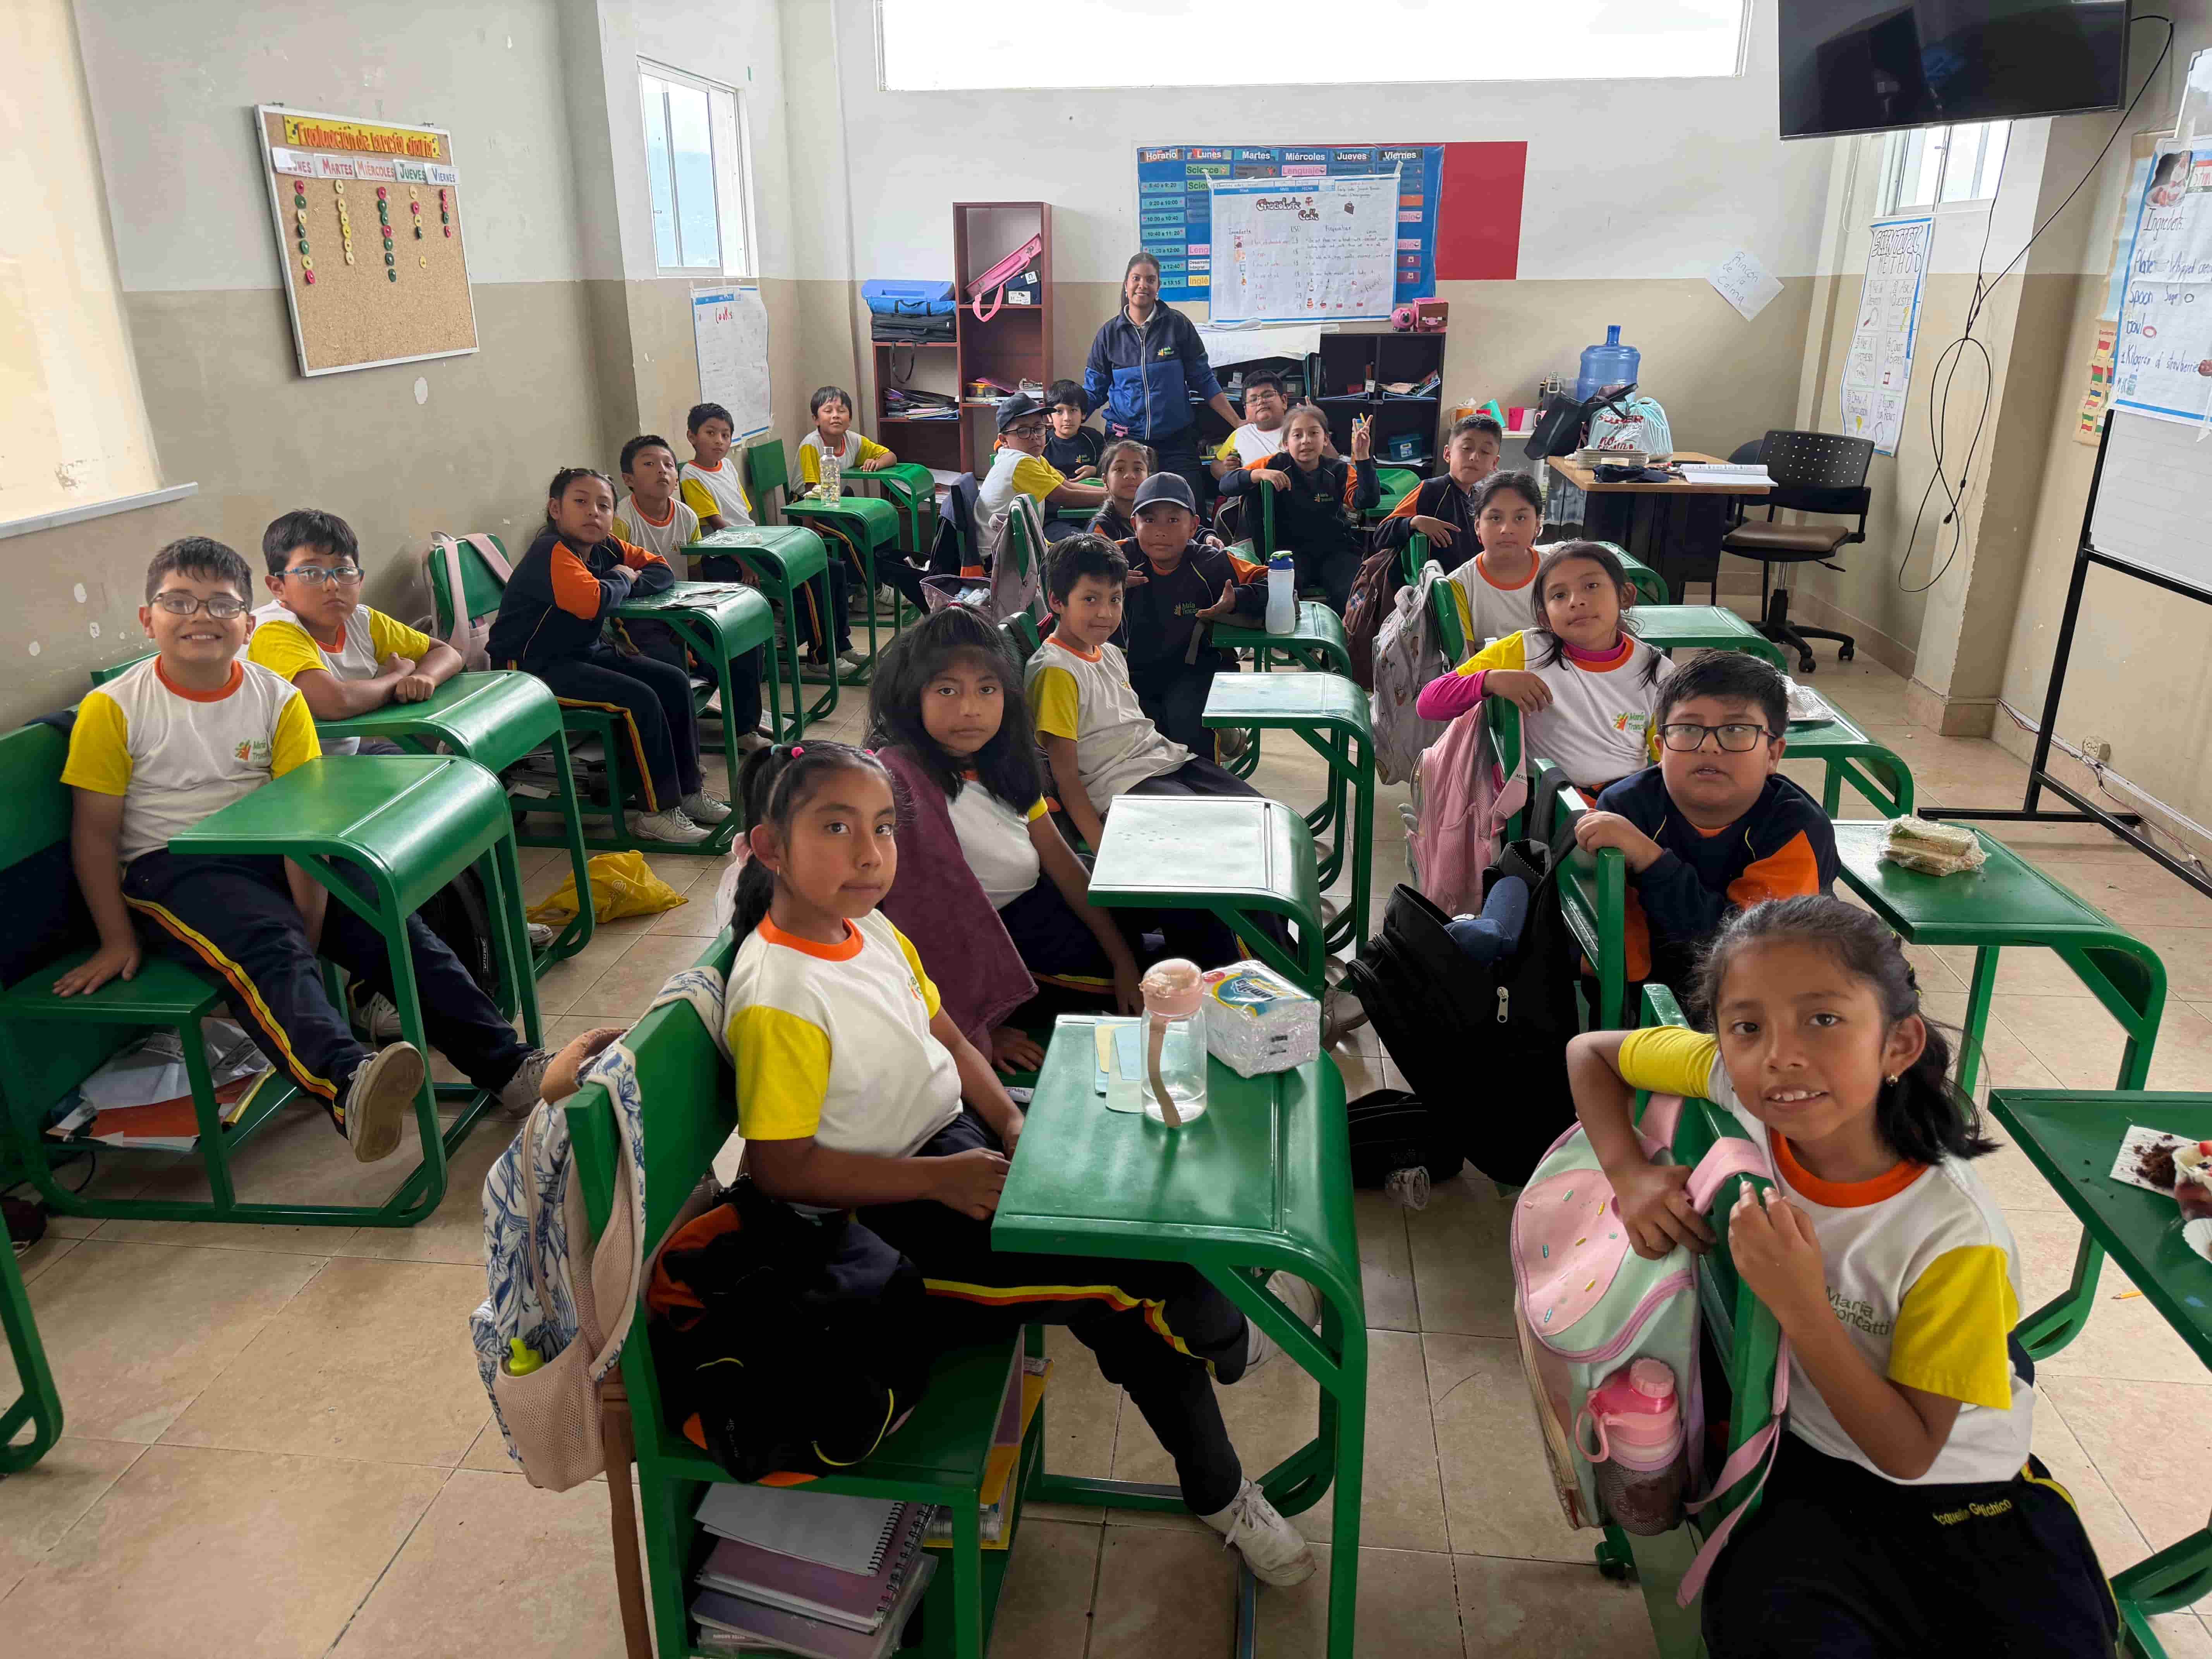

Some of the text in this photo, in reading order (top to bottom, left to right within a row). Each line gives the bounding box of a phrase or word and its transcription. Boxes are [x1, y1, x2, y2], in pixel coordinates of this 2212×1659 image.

[1146, 152, 1176, 160] Horario
[1197, 150, 1221, 158] Lunes
[1242, 151, 1271, 159] Martes
[1285, 151, 1326, 161] Miércoles
[1337, 152, 1367, 160] Jueves
[1384, 151, 1417, 159] Viernes
[1283, 167, 1319, 175] Lenguaje
[1825, 1285, 1874, 1320] María
[1832, 1307, 1892, 1334] oncatti
